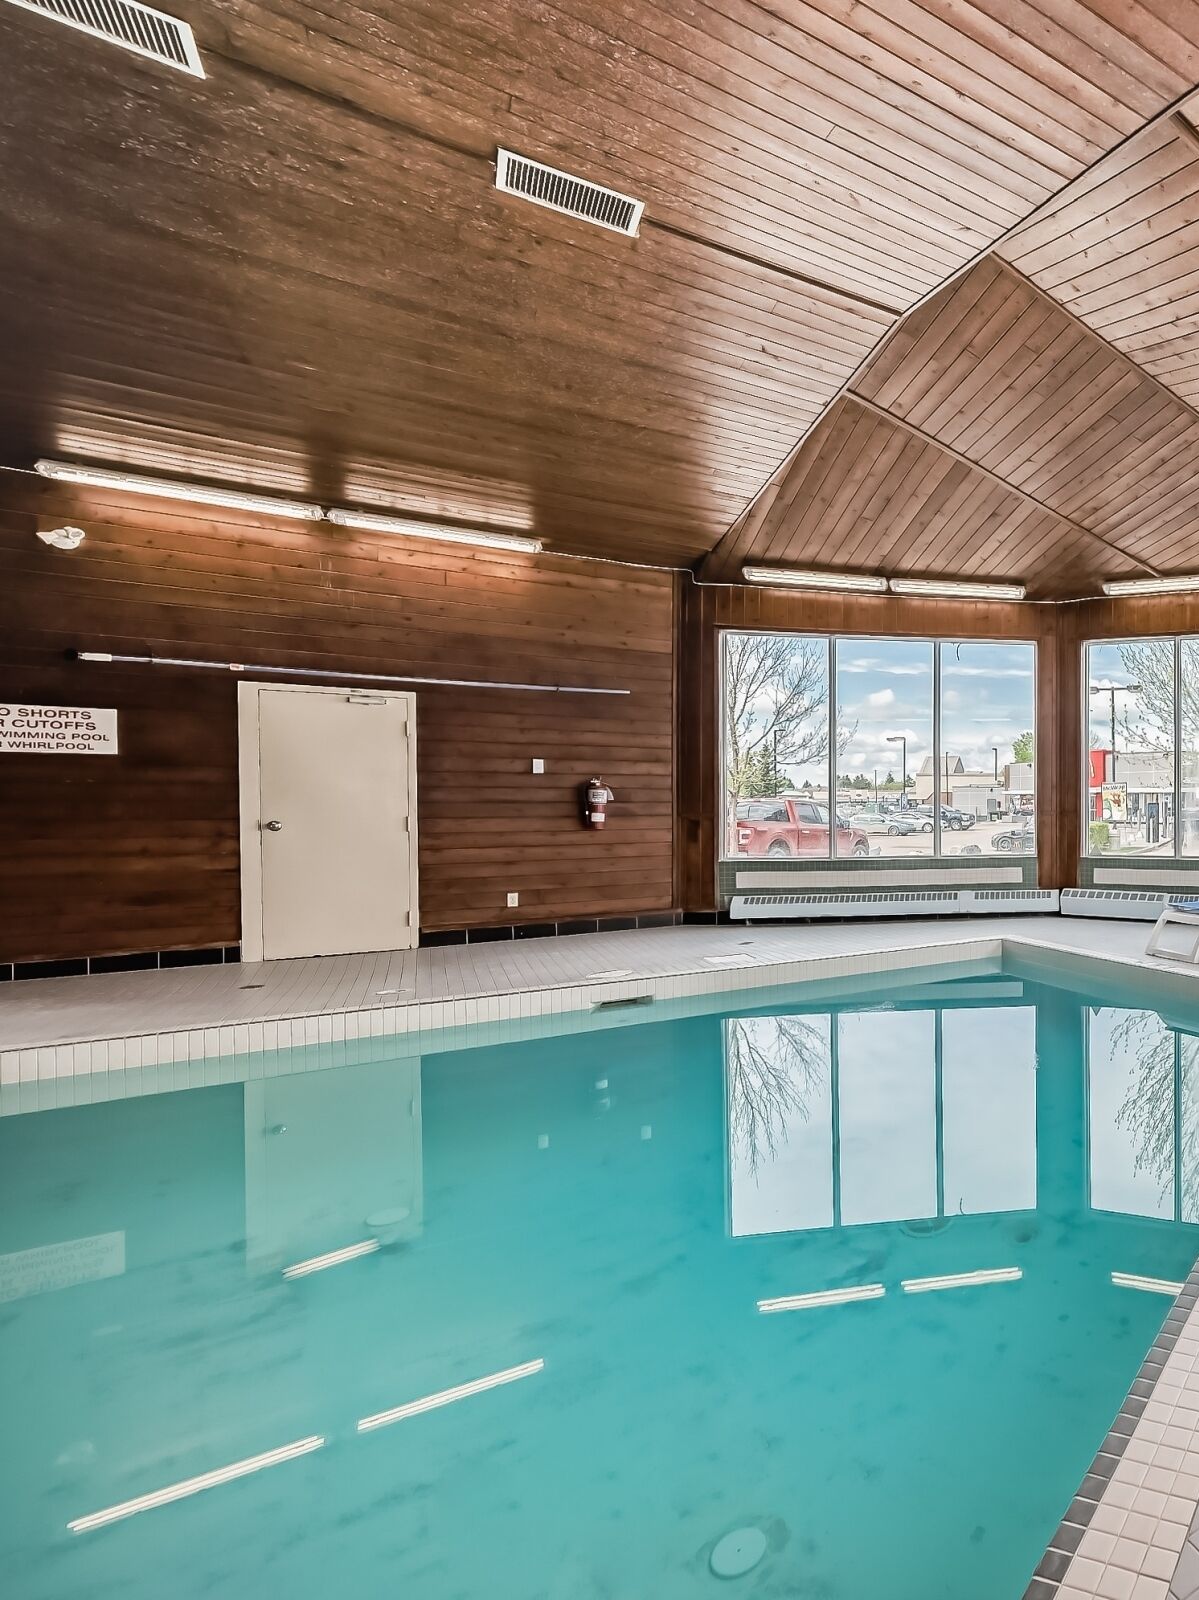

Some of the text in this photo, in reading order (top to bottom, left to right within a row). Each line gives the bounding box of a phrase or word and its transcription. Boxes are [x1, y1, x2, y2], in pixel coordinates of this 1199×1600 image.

[18, 708, 92, 720] SHORTS
[11, 719, 97, 731] CUTOFFS
[0, 730, 110, 742] WIMMING POOL
[7, 740, 95, 751] WHIRLPOOL
